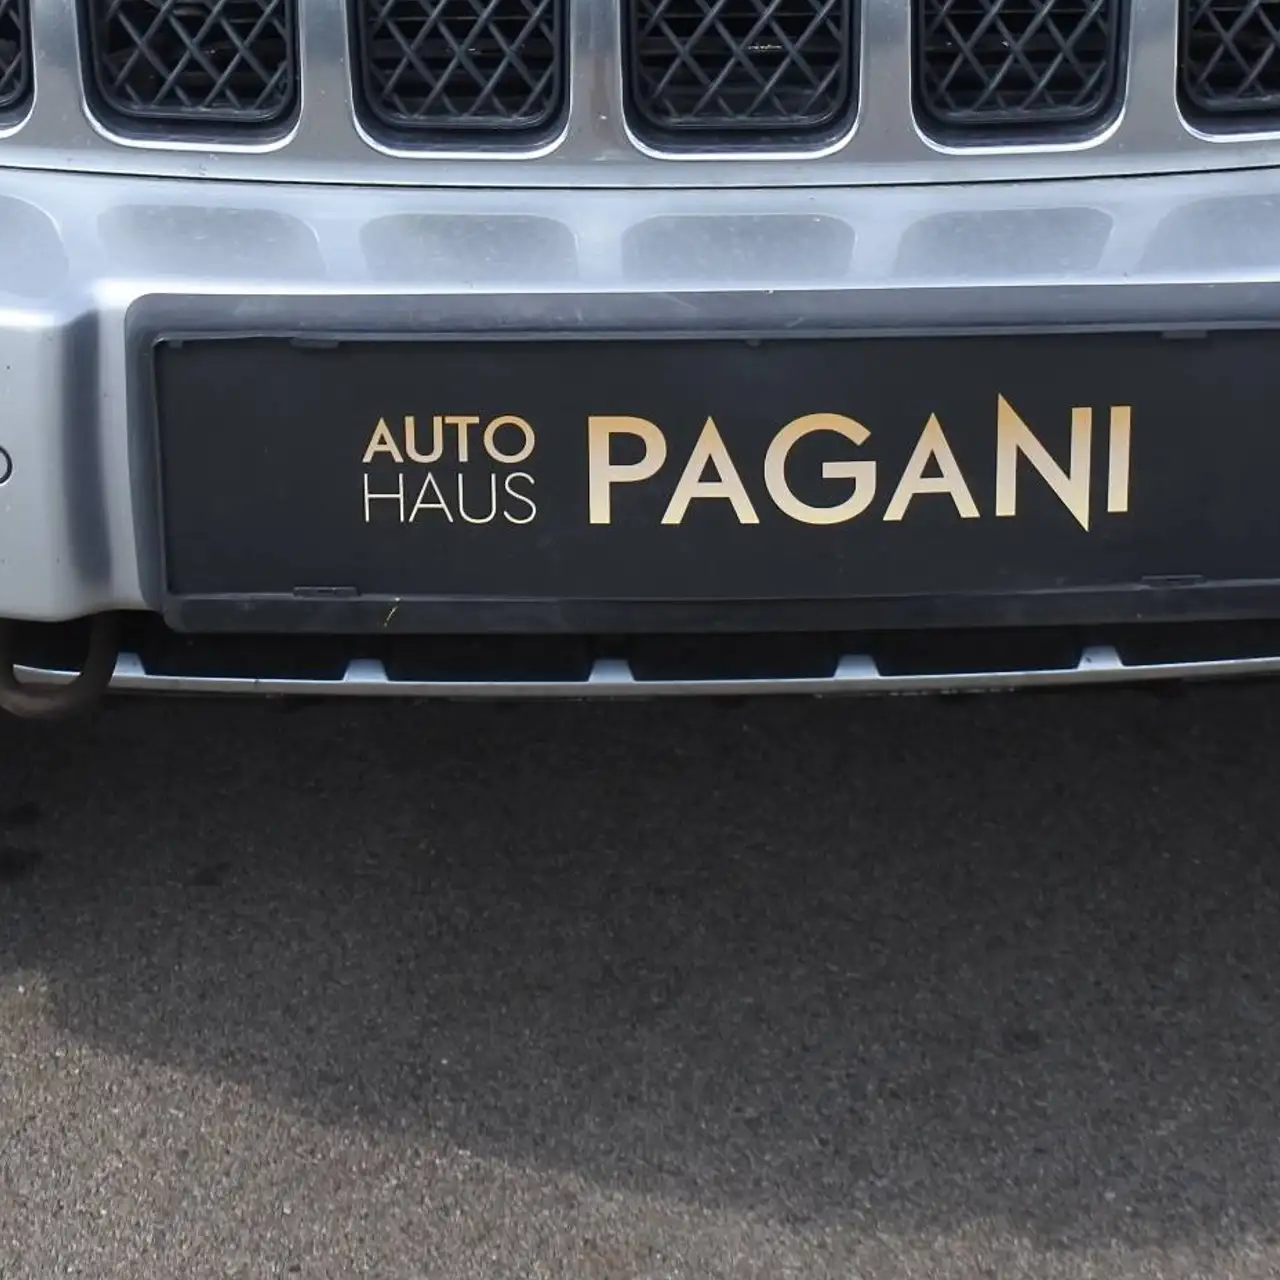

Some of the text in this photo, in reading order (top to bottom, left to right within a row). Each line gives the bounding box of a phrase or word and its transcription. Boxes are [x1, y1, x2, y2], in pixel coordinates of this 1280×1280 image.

[362, 414, 536, 464] AUTO
[587, 392, 1132, 533] PAGANI
[362, 471, 537, 524] HAUS
